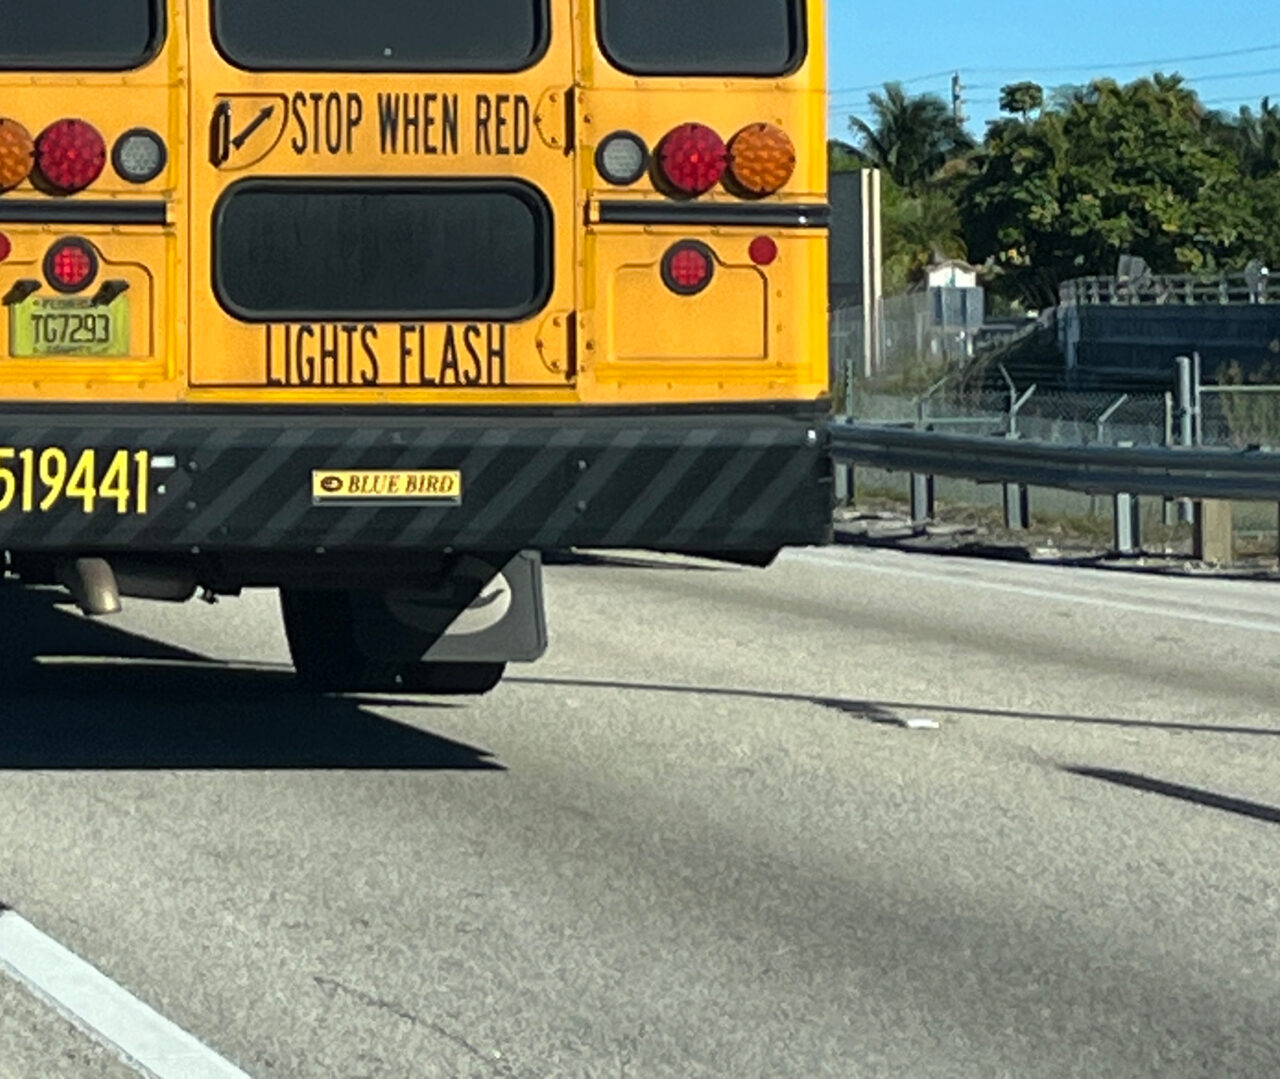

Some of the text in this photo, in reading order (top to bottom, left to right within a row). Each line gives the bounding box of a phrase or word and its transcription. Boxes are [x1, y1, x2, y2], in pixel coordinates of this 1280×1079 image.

[291, 91, 530, 155] STOP WHEN RED
[30, 313, 110, 344] TG7293
[265, 322, 507, 386] LIGHTS FLASH
[347, 474, 454, 494] BLUE BIRD
